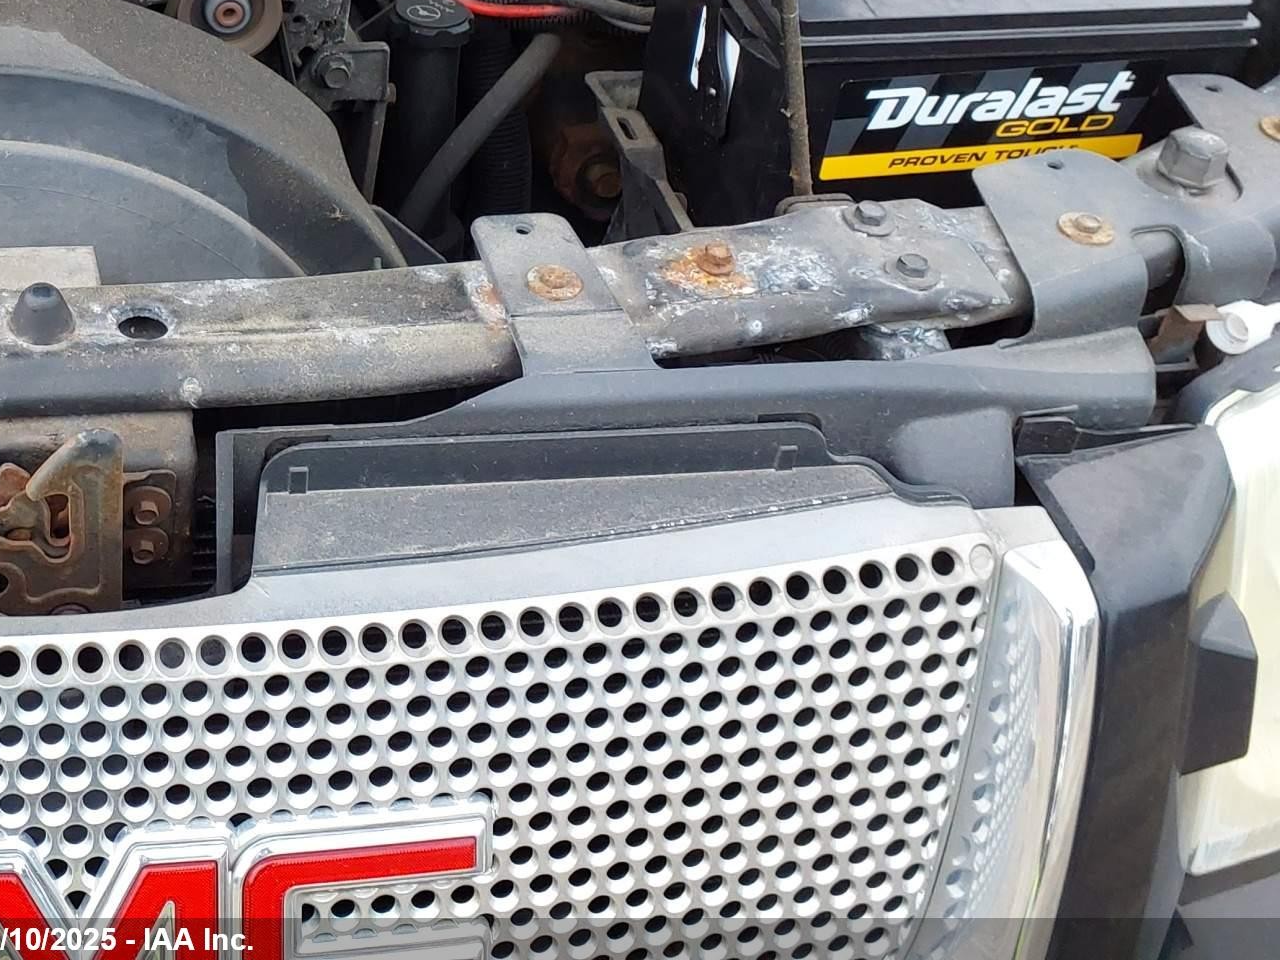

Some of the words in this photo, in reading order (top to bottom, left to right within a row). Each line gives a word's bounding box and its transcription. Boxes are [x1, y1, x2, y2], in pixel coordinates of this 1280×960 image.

[866, 71, 1132, 132] Duralast
[995, 114, 1115, 138] GOLD
[888, 150, 986, 169] PROVEN
